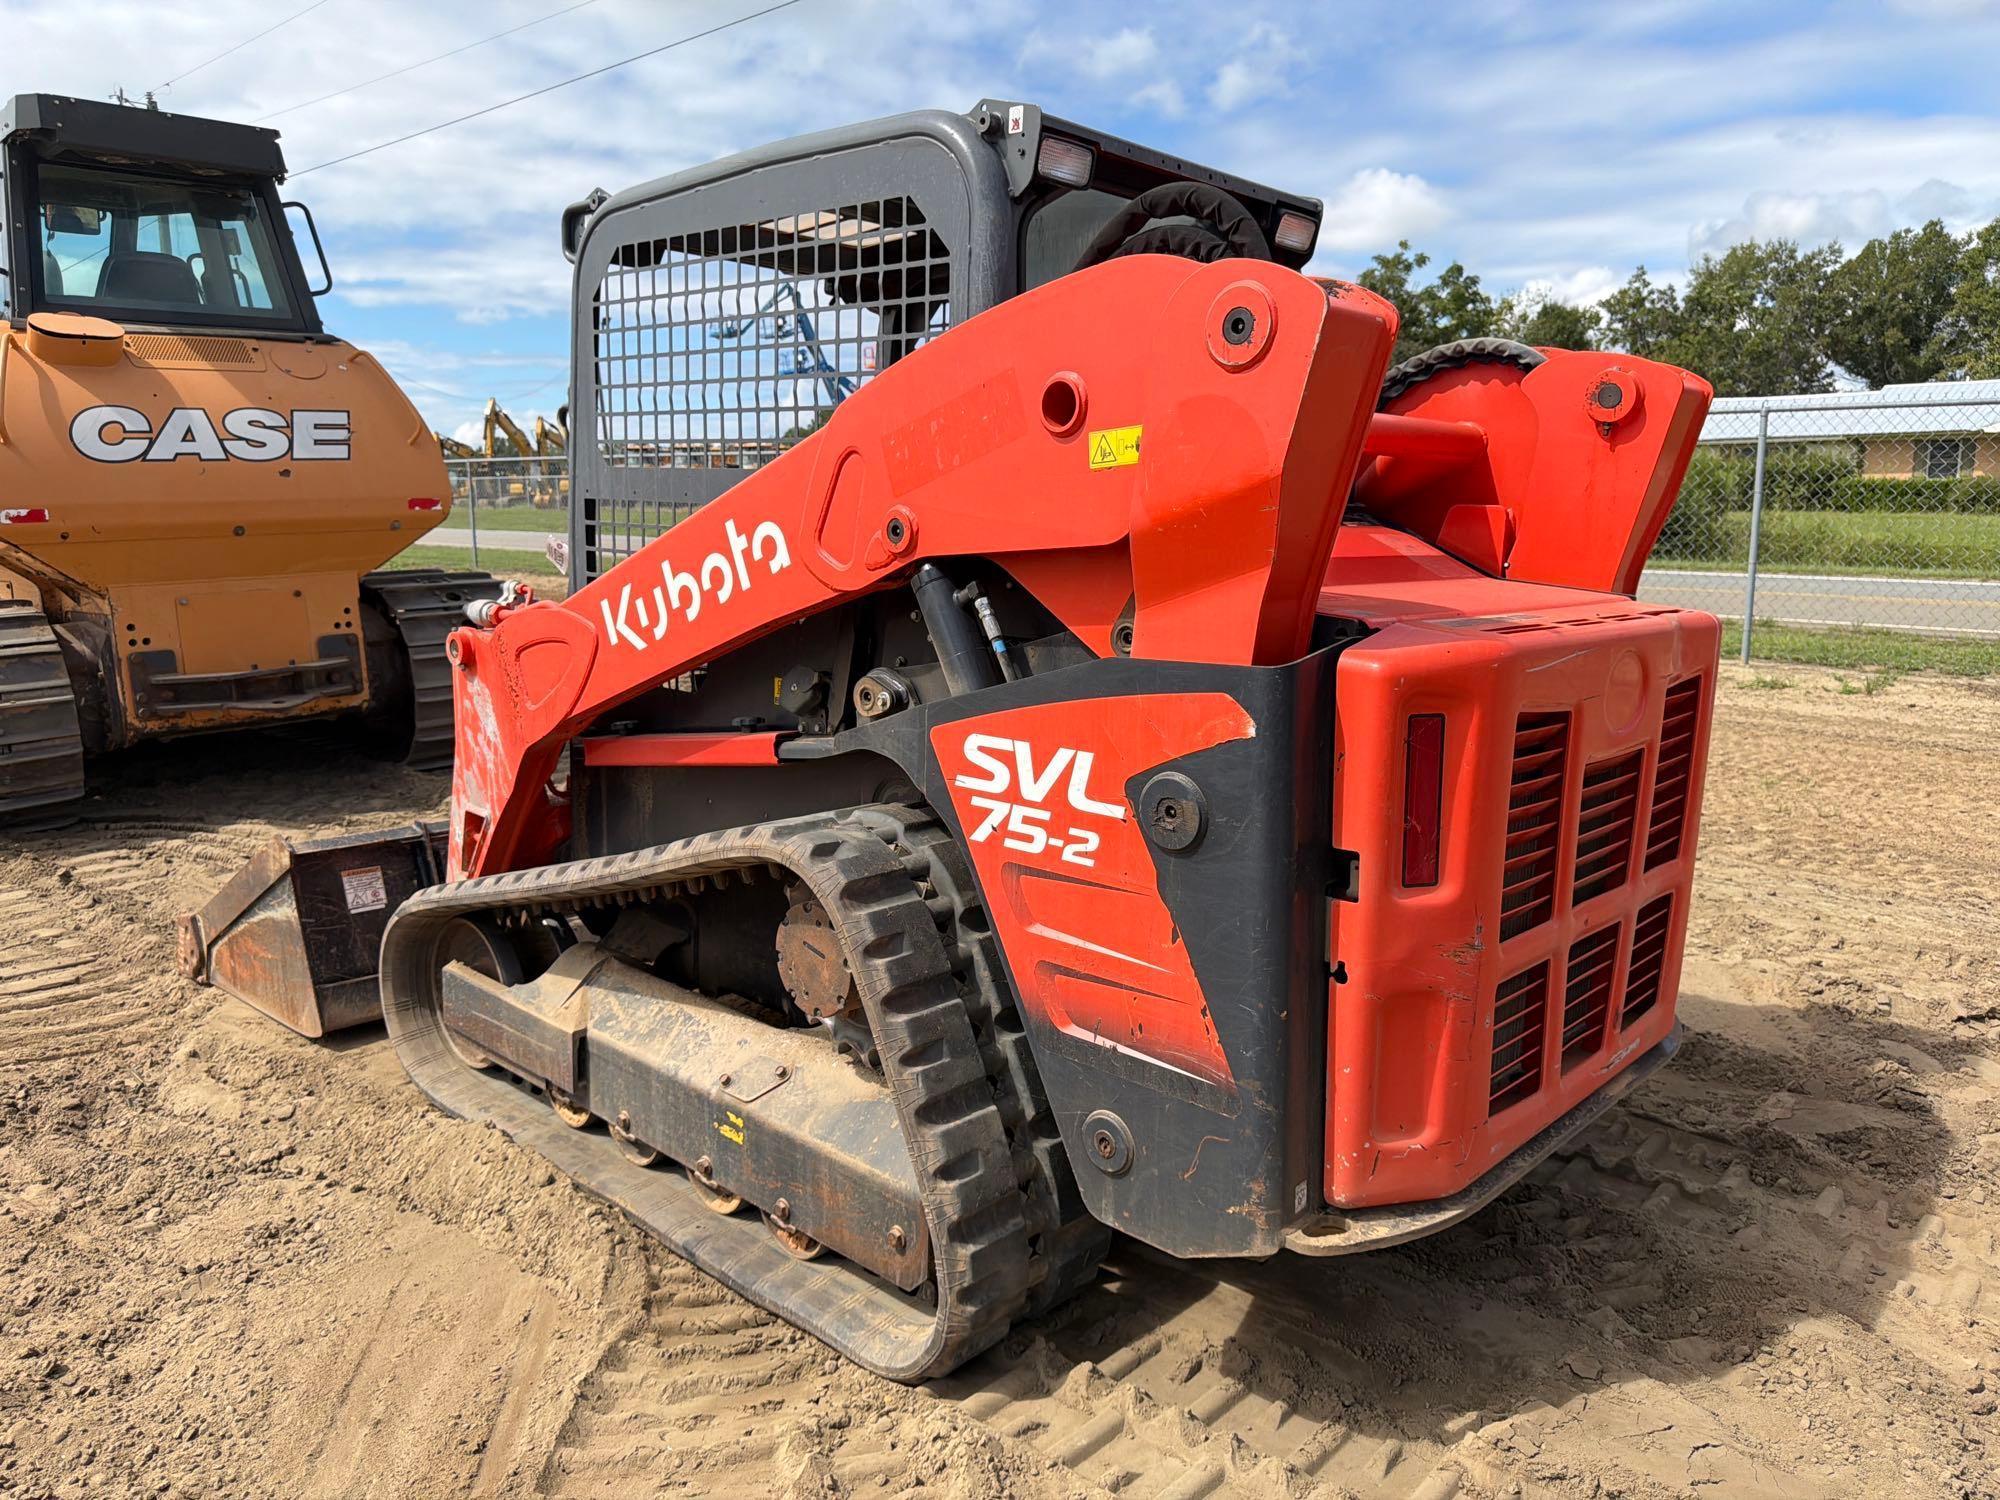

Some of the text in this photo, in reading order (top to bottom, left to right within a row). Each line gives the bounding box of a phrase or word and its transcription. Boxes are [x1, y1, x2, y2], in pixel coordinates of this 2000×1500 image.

[70, 405, 351, 463] CASE
[600, 518, 790, 650] Kubota
[955, 733, 1126, 819] SVL
[969, 795, 1100, 867] 75-2
